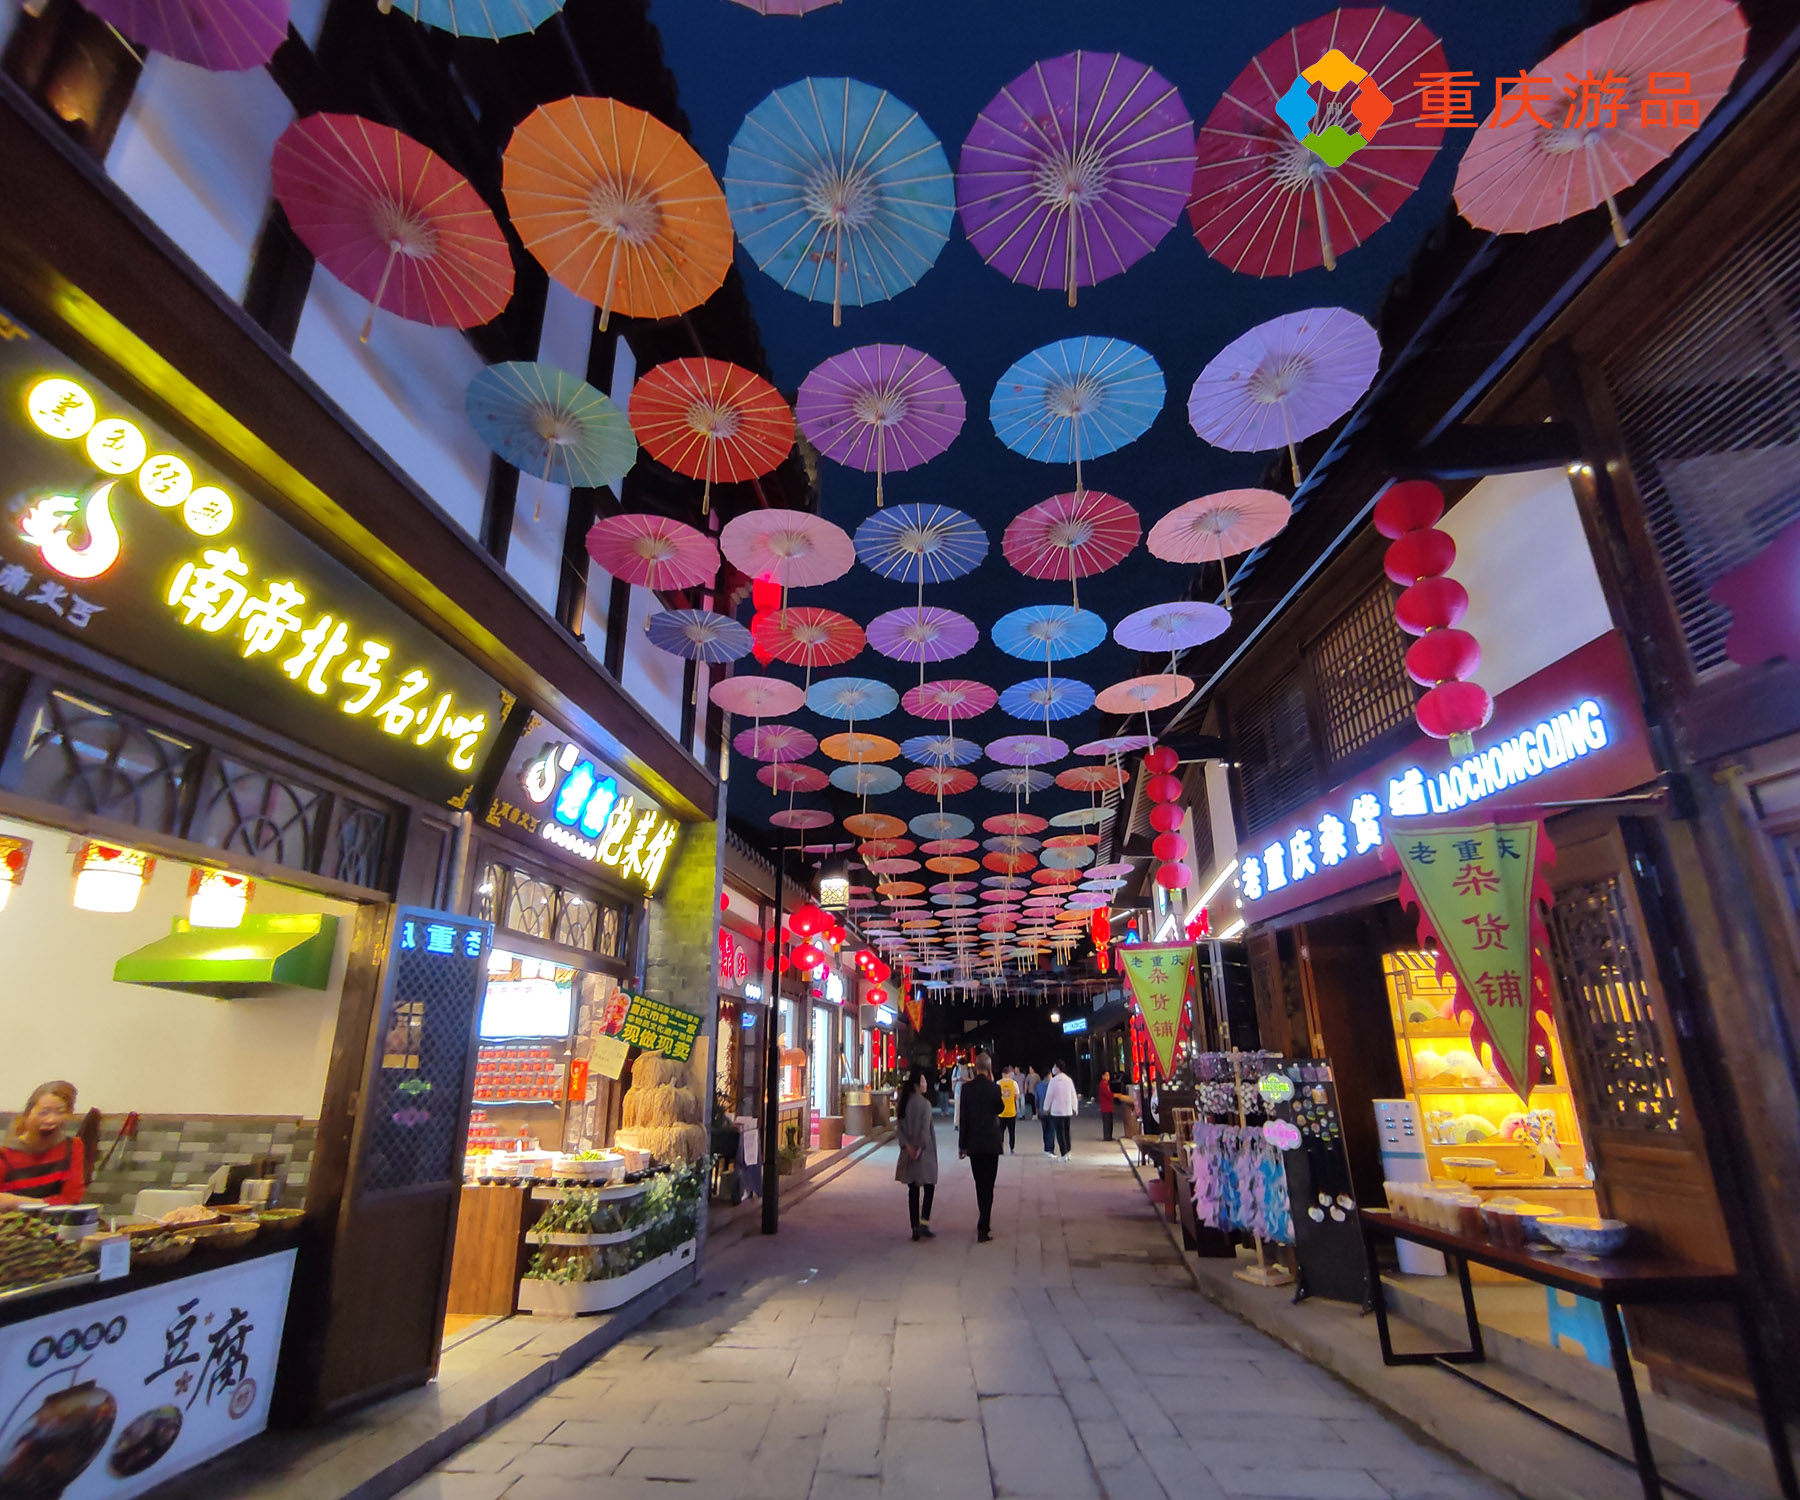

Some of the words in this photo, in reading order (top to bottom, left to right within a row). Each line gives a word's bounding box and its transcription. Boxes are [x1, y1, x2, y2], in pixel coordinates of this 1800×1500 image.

[167, 546, 486, 771] 南帝北丐名小吃
[1427, 699, 1608, 813] LAOCHONGQING
[1241, 767, 1428, 900] 老重庆杂货铺
[1409, 837, 1521, 864] 老重庆
[1130, 954, 1185, 968] 老重庆
[1452, 864, 1523, 1009] 杂货铺
[621, 1022, 691, 1061] 现做现卖
[1148, 968, 1173, 1037] 杂货铺
[144, 1297, 254, 1412] 豆腐
